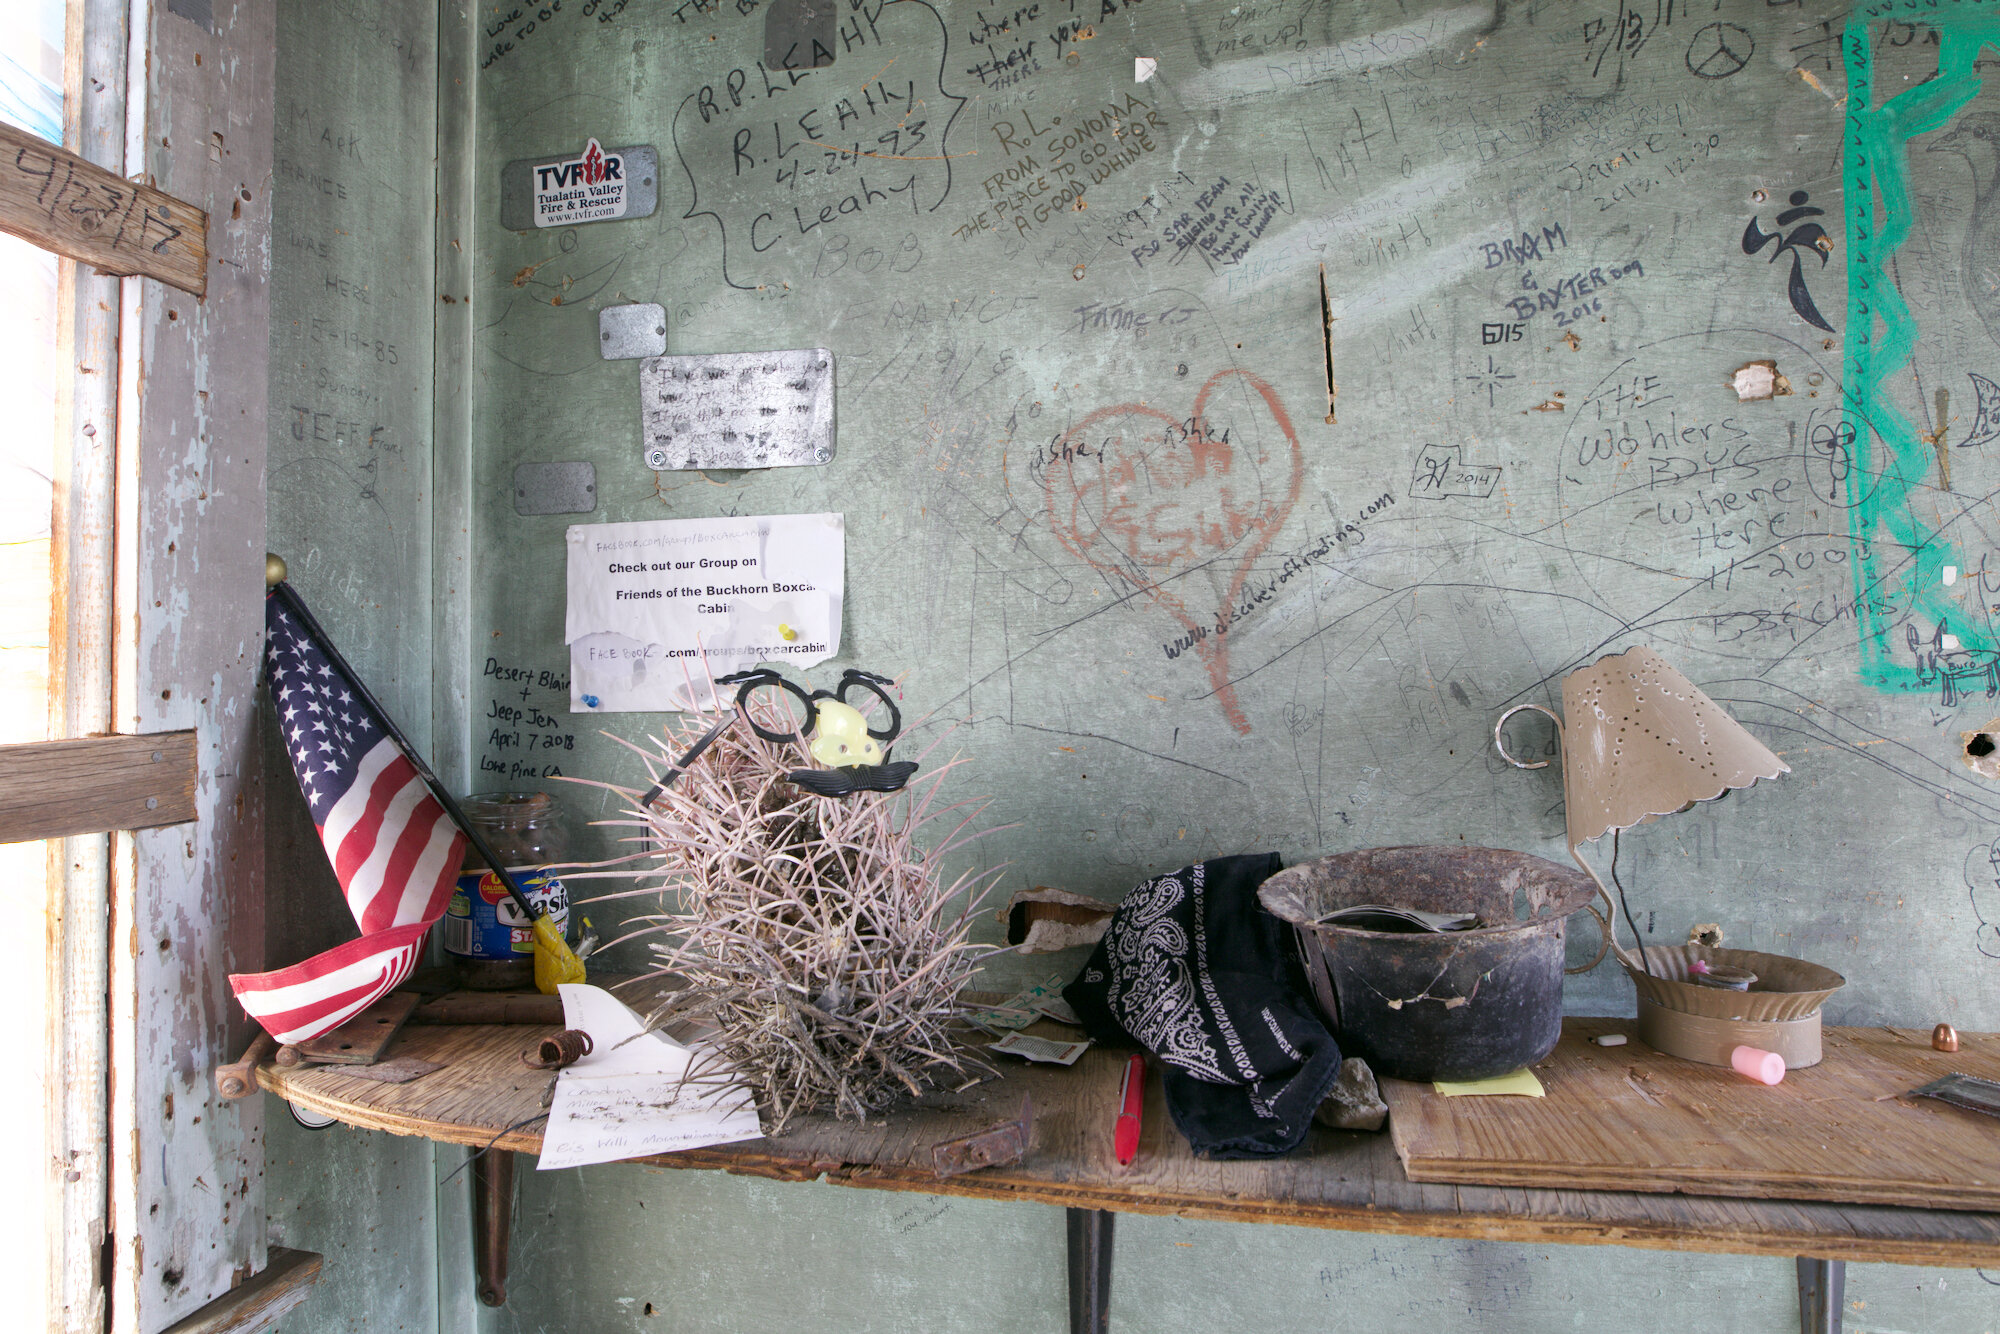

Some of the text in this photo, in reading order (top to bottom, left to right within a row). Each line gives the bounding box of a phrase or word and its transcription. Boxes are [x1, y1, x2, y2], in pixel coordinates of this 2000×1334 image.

[981, 92, 1150, 200] FROM SONOMA
[993, 176, 1050, 222] PLACE
[1050, 162, 1077, 183] TO
[1080, 142, 1107, 165] GO
[1117, 111, 1170, 147] FOR
[537, 184, 624, 204] Tualatin Valley
[1014, 215, 1033, 238] A
[1033, 180, 1088, 224] GOOD
[1090, 137, 1157, 186] WHINE
[540, 194, 622, 214] Fire & Rescue
[546, 206, 616, 224] www.tvfr.com
[1163, 211, 1194, 243] SAR
[1504, 266, 1608, 321] BAXTER
[1552, 296, 1603, 328] 2016
[310, 317, 399, 366] 5-19-85
[1455, 473, 1489, 485] 2014
[608, 557, 758, 574] Check out our Group on
[615, 589, 663, 600] Friends
[666, 587, 679, 598] of
[681, 586, 703, 598] the
[706, 584, 769, 597] Buckhorn
[483, 657, 534, 685] Desert
[519, 686, 532, 702] +
[486, 699, 559, 729] Jeep Jen
[488, 728, 575, 752] April 7 2018
[480, 754, 507, 775] Lone
